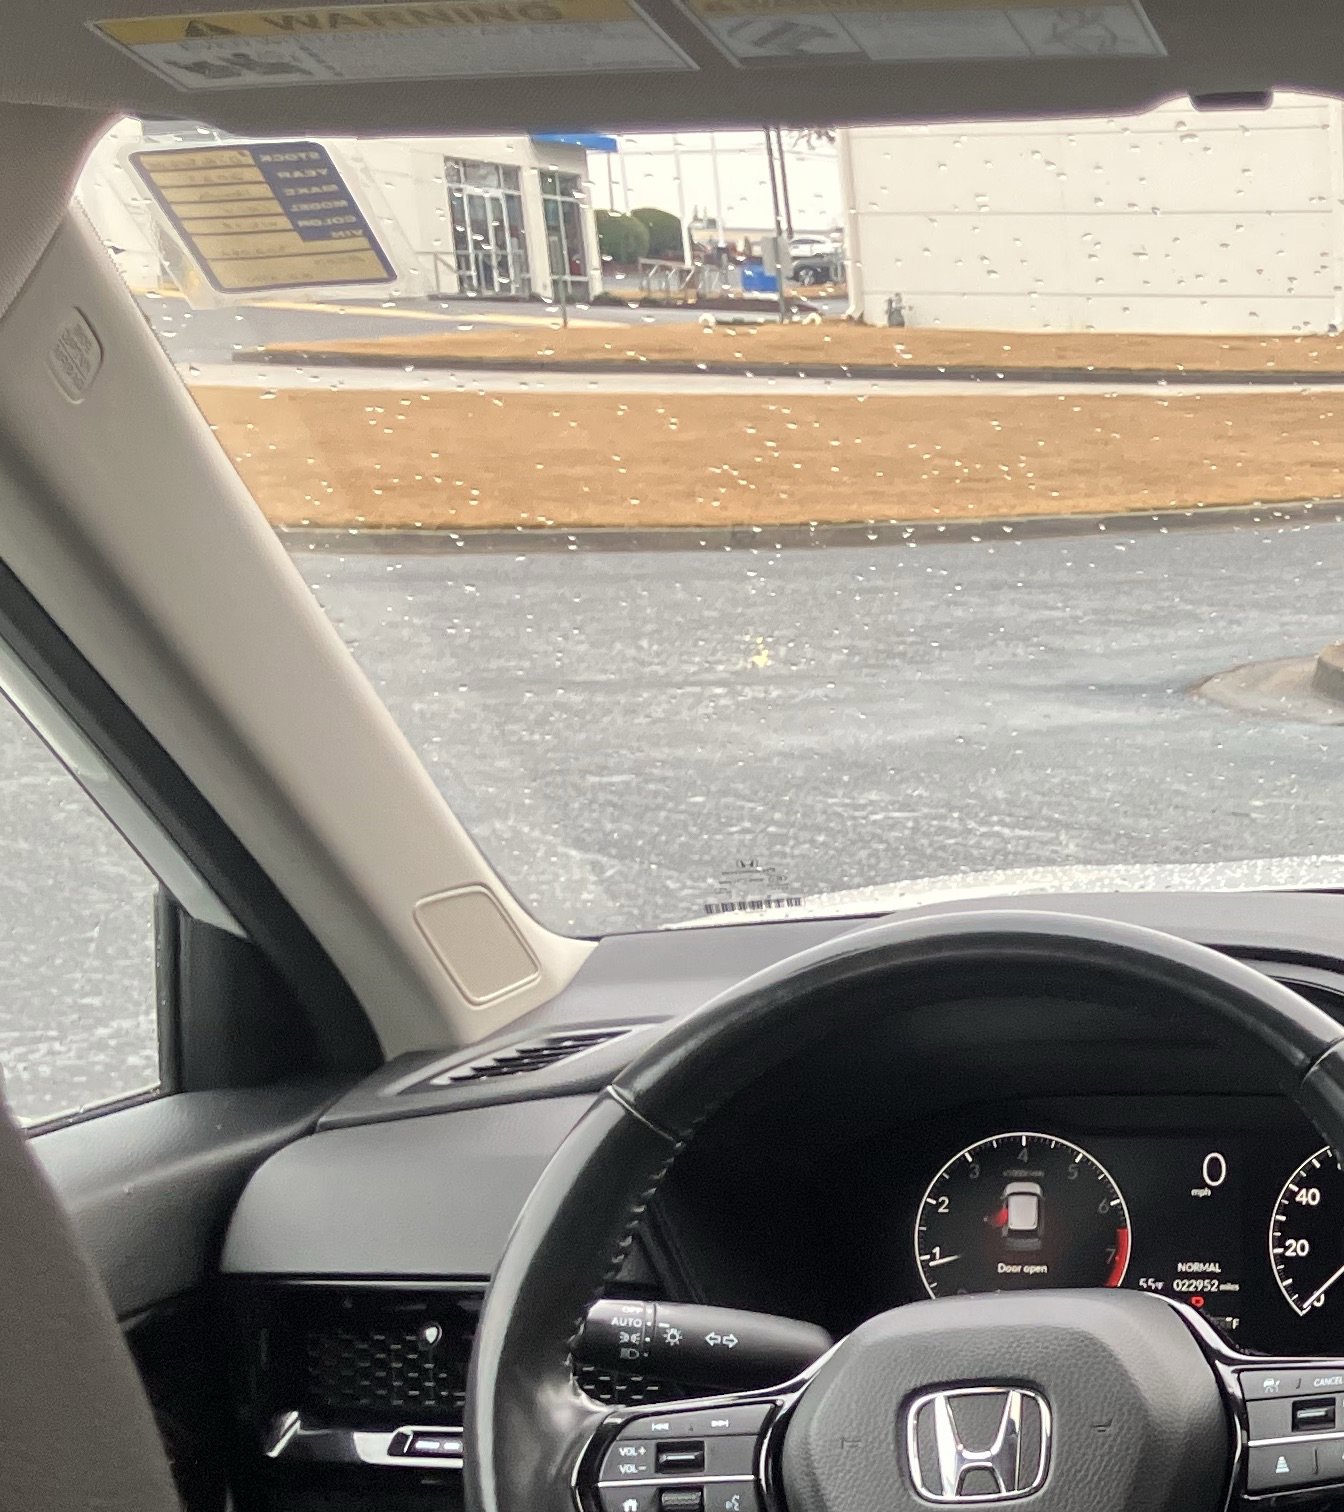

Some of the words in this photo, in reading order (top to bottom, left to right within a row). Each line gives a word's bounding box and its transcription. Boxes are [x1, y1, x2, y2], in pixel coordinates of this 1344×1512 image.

[1018, 1149, 1029, 1163] 4
[969, 1164, 980, 1179] 3
[1067, 1164, 1079, 1180] 5
[1202, 1152, 1227, 1187] 0
[1295, 1188, 1321, 1206] 40
[937, 1196, 949, 1213] 2
[1099, 1199, 1110, 1214] 6
[932, 1246, 941, 1260] 1
[1284, 1239, 1310, 1257] 20
[997, 1263, 1021, 1273] Door
[1023, 1264, 1048, 1275] open
[1177, 1262, 1222, 1273] NORMAL
[1173, 1279, 1219, 1292] 022952
[611, 1317, 643, 1328] AUTO
[1314, 1376, 1344, 1387] CANCEL
